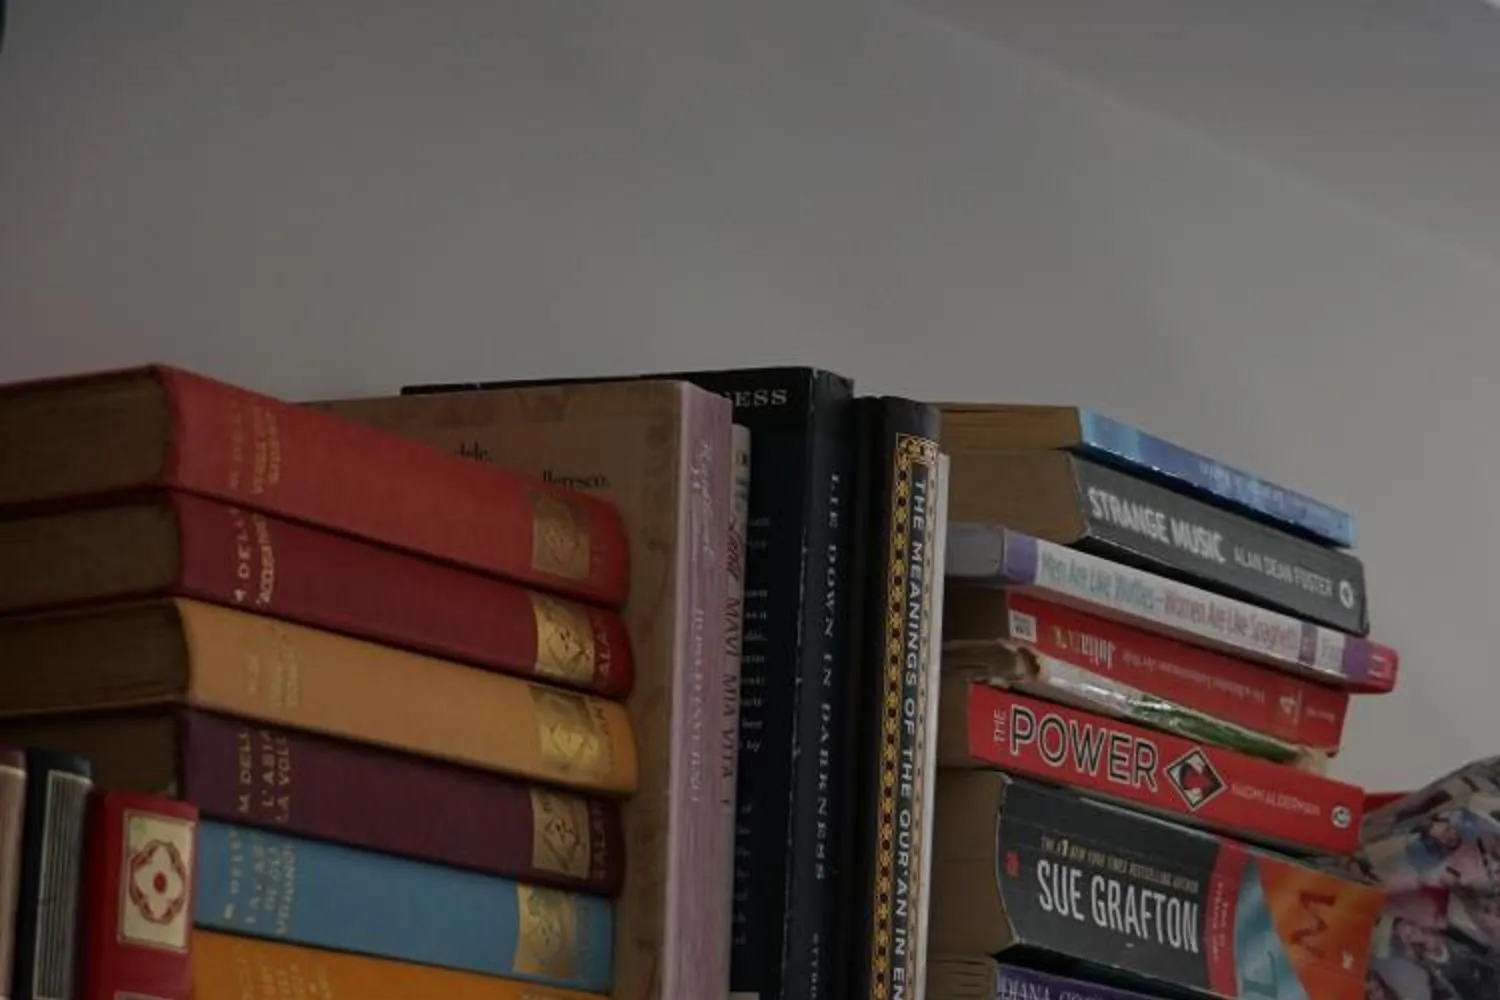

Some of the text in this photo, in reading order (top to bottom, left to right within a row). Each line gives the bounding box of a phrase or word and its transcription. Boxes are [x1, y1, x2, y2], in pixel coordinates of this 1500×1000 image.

[912, 478, 926, 537] THE
[1087, 486, 1168, 551] STRANGE
[1169, 517, 1228, 565] MUSIC
[823, 543, 838, 638] DOWN
[1233, 545, 1263, 573] ALAN
[1263, 556, 1293, 584] DEAN
[904, 542, 924, 687] MEANINGS
[902, 700, 917, 737] OF
[993, 704, 1159, 793] THE POWER
[898, 743, 915, 798] THE
[892, 924, 908, 956] IN
[1036, 858, 1086, 924] SUE
[1090, 874, 1200, 954] GRAFTON
